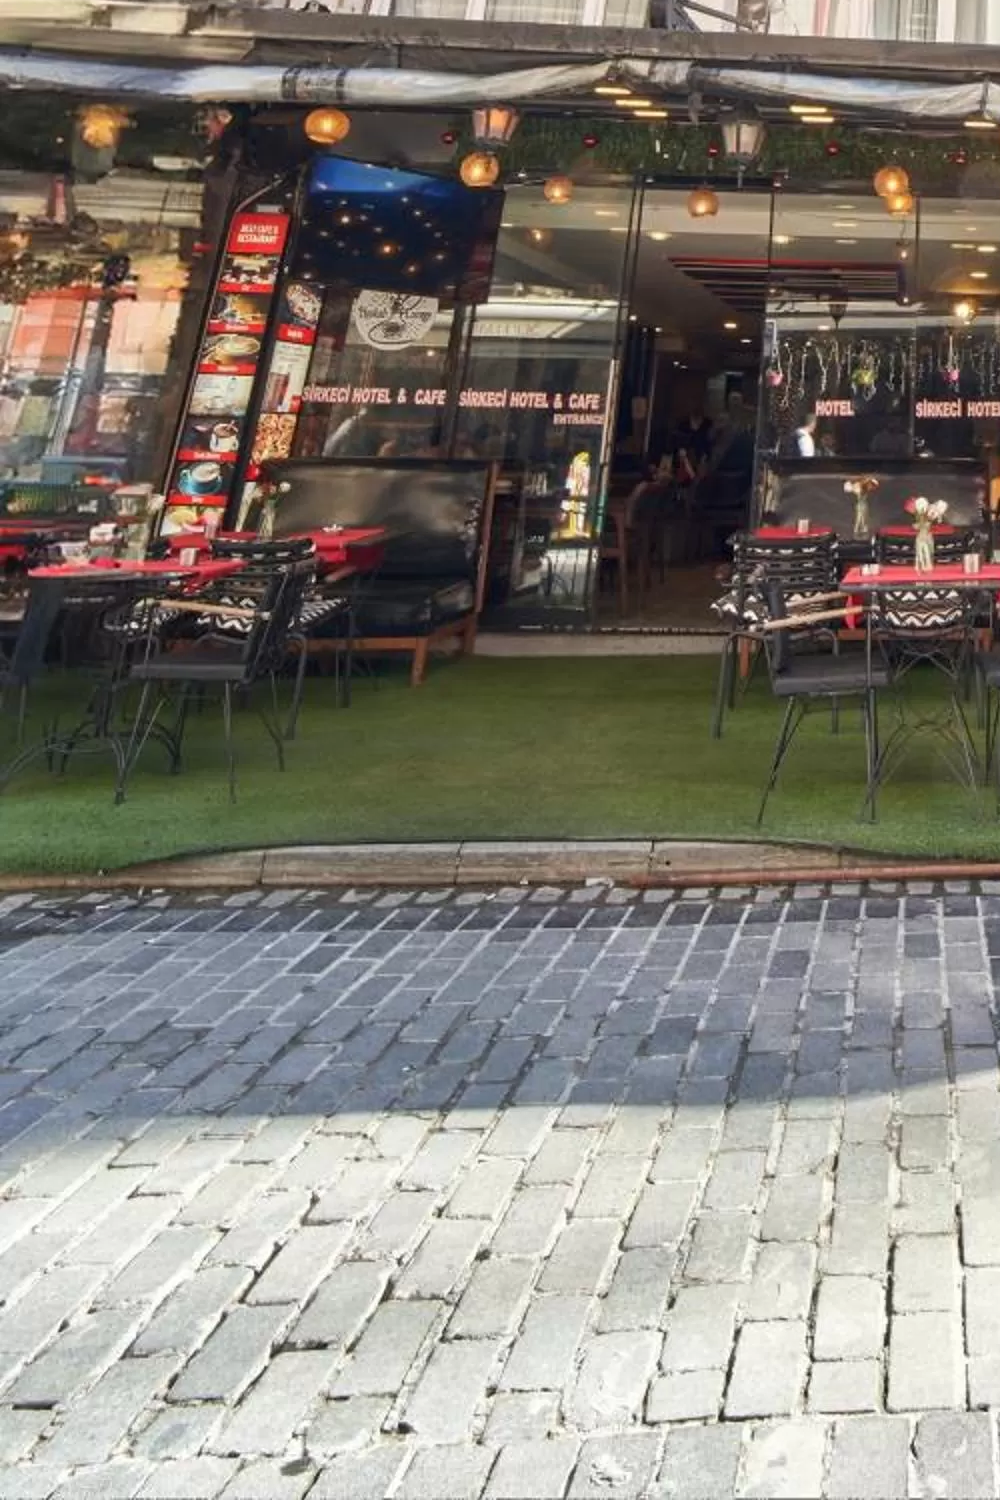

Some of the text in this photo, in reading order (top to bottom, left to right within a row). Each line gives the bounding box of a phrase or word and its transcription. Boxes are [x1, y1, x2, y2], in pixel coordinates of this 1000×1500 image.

[352, 387, 391, 404] HOTEL
[397, 388, 406, 405] &
[415, 389, 447, 405] CAFE
[509, 391, 549, 409] HOTEL
[553, 393, 562, 409] &
[568, 393, 601, 410] CAFE
[815, 400, 855, 417] HOTEL
